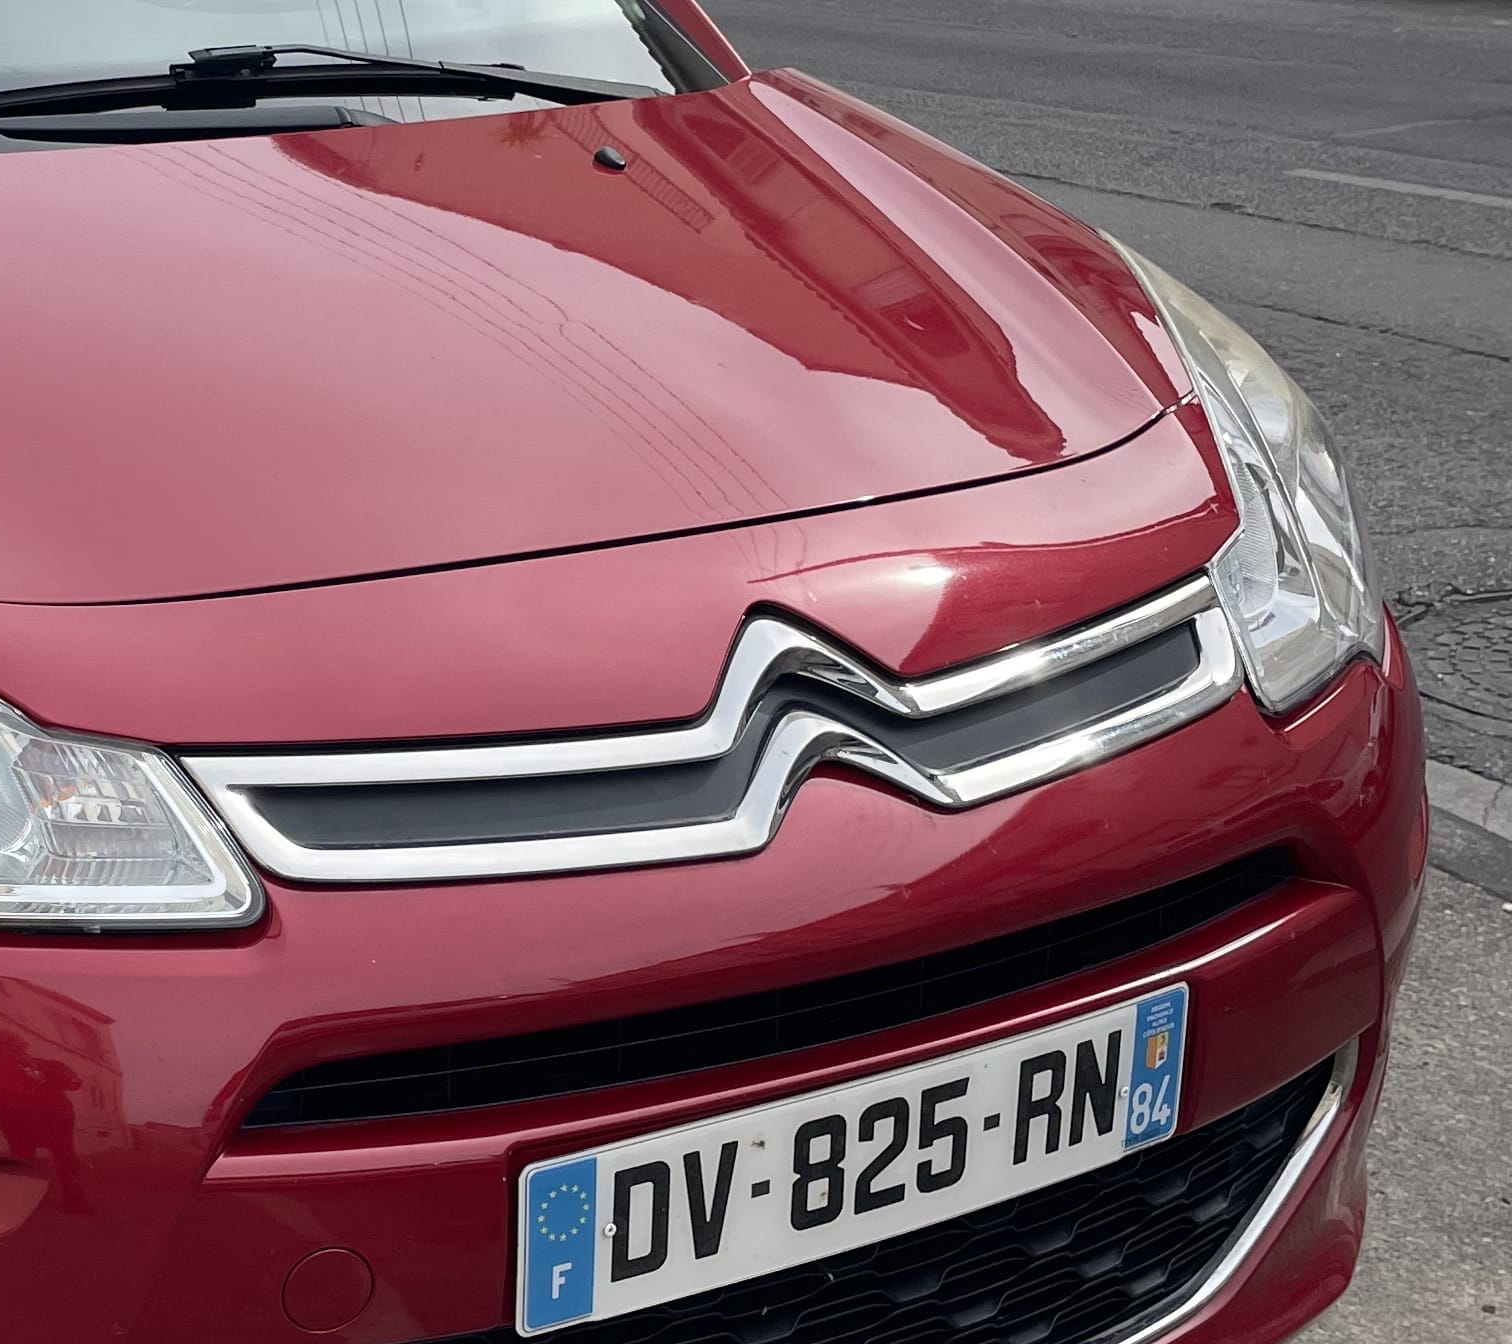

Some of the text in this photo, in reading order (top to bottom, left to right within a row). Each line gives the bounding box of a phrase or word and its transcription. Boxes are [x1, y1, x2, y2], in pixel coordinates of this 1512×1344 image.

[1130, 1074, 1171, 1135] 84
[611, 1029, 1123, 1283] DV-825-RN
[551, 1262, 572, 1299] F
